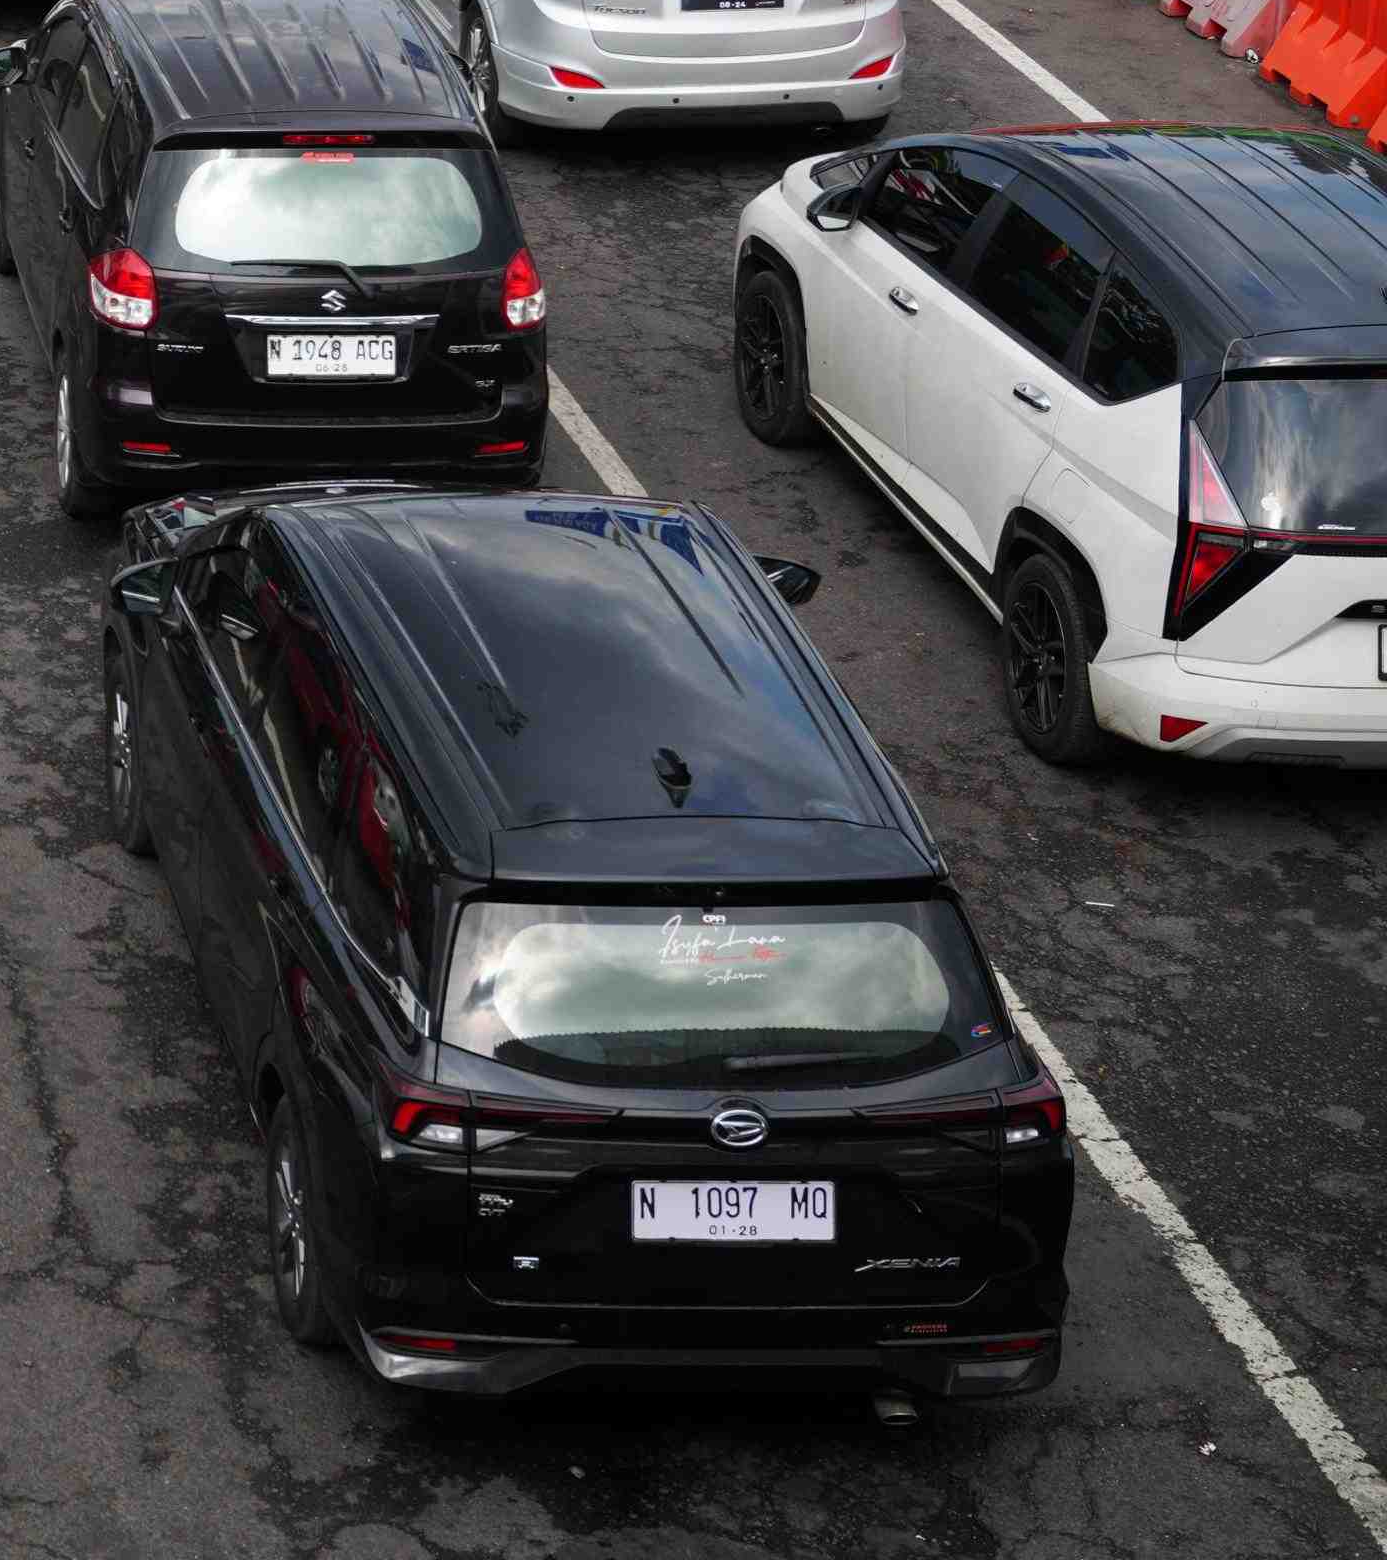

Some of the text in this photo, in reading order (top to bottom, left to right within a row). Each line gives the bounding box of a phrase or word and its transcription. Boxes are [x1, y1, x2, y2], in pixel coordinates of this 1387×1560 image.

[269, 338, 394, 361] N 1948 ACG
[639, 1187, 829, 1220] N 1097 MQ
